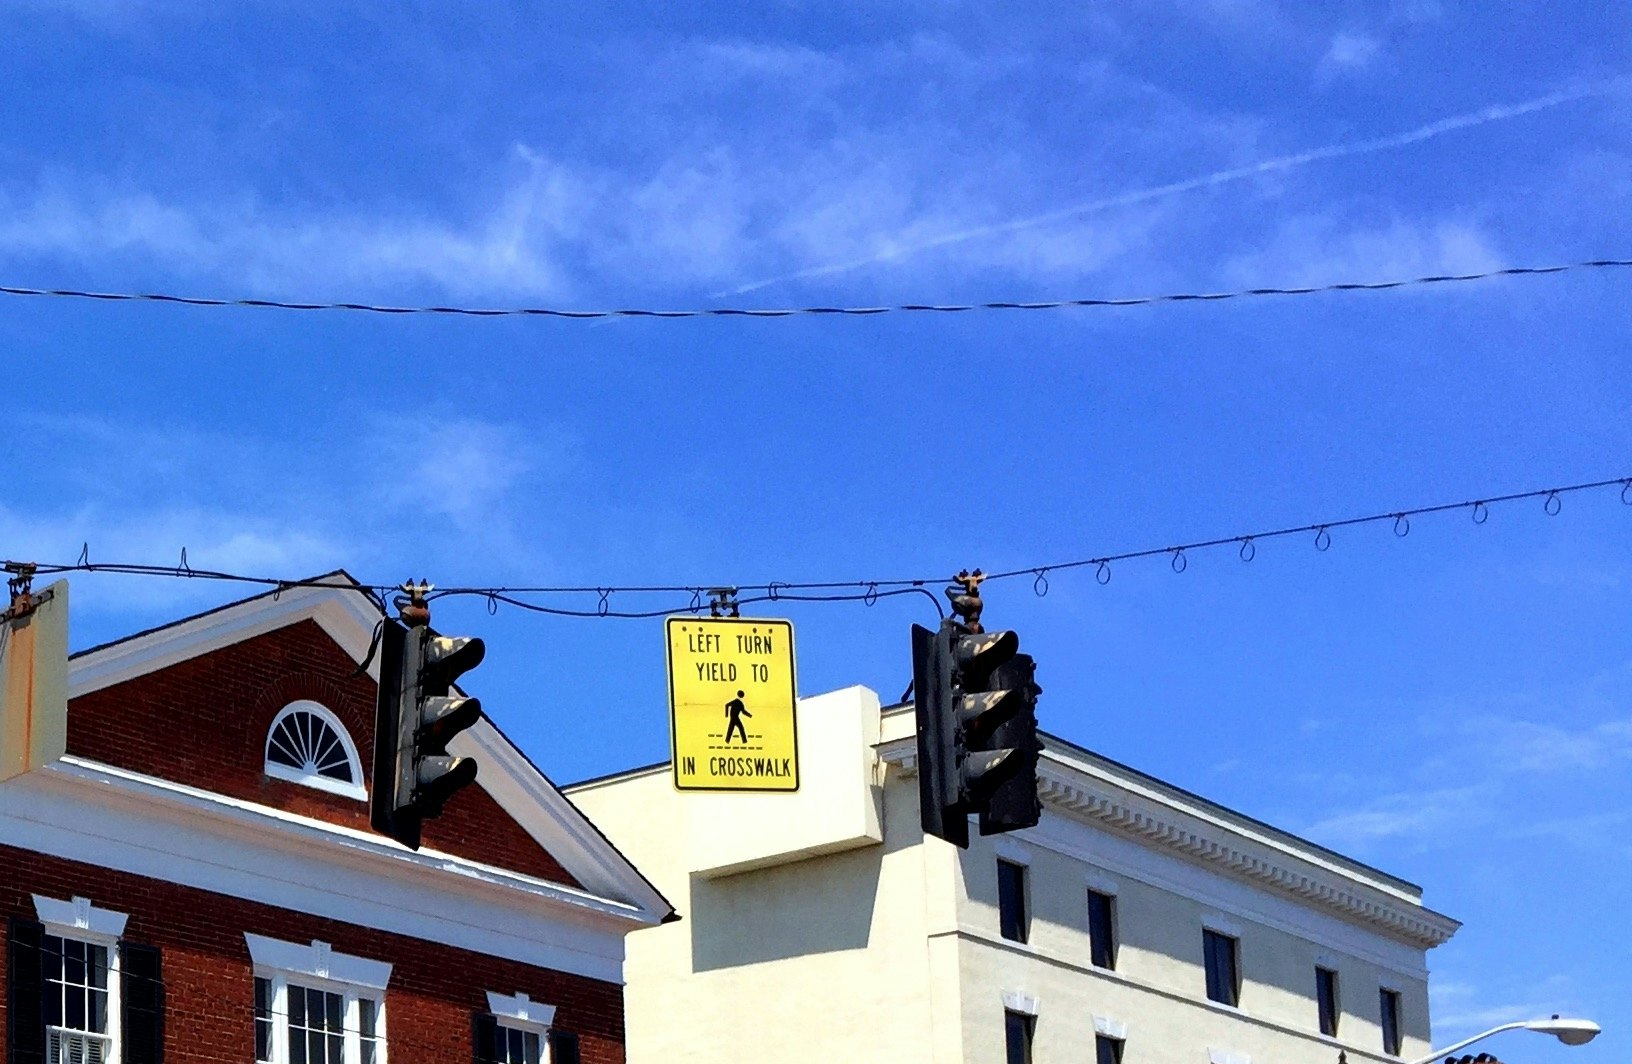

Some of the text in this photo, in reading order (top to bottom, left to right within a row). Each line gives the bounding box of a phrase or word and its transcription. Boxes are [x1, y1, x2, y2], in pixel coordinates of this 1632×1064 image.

[689, 634, 772, 655] LEFT TURN
[696, 662, 768, 683] YIELD TO
[682, 756, 791, 777] IN CROSSWALK
